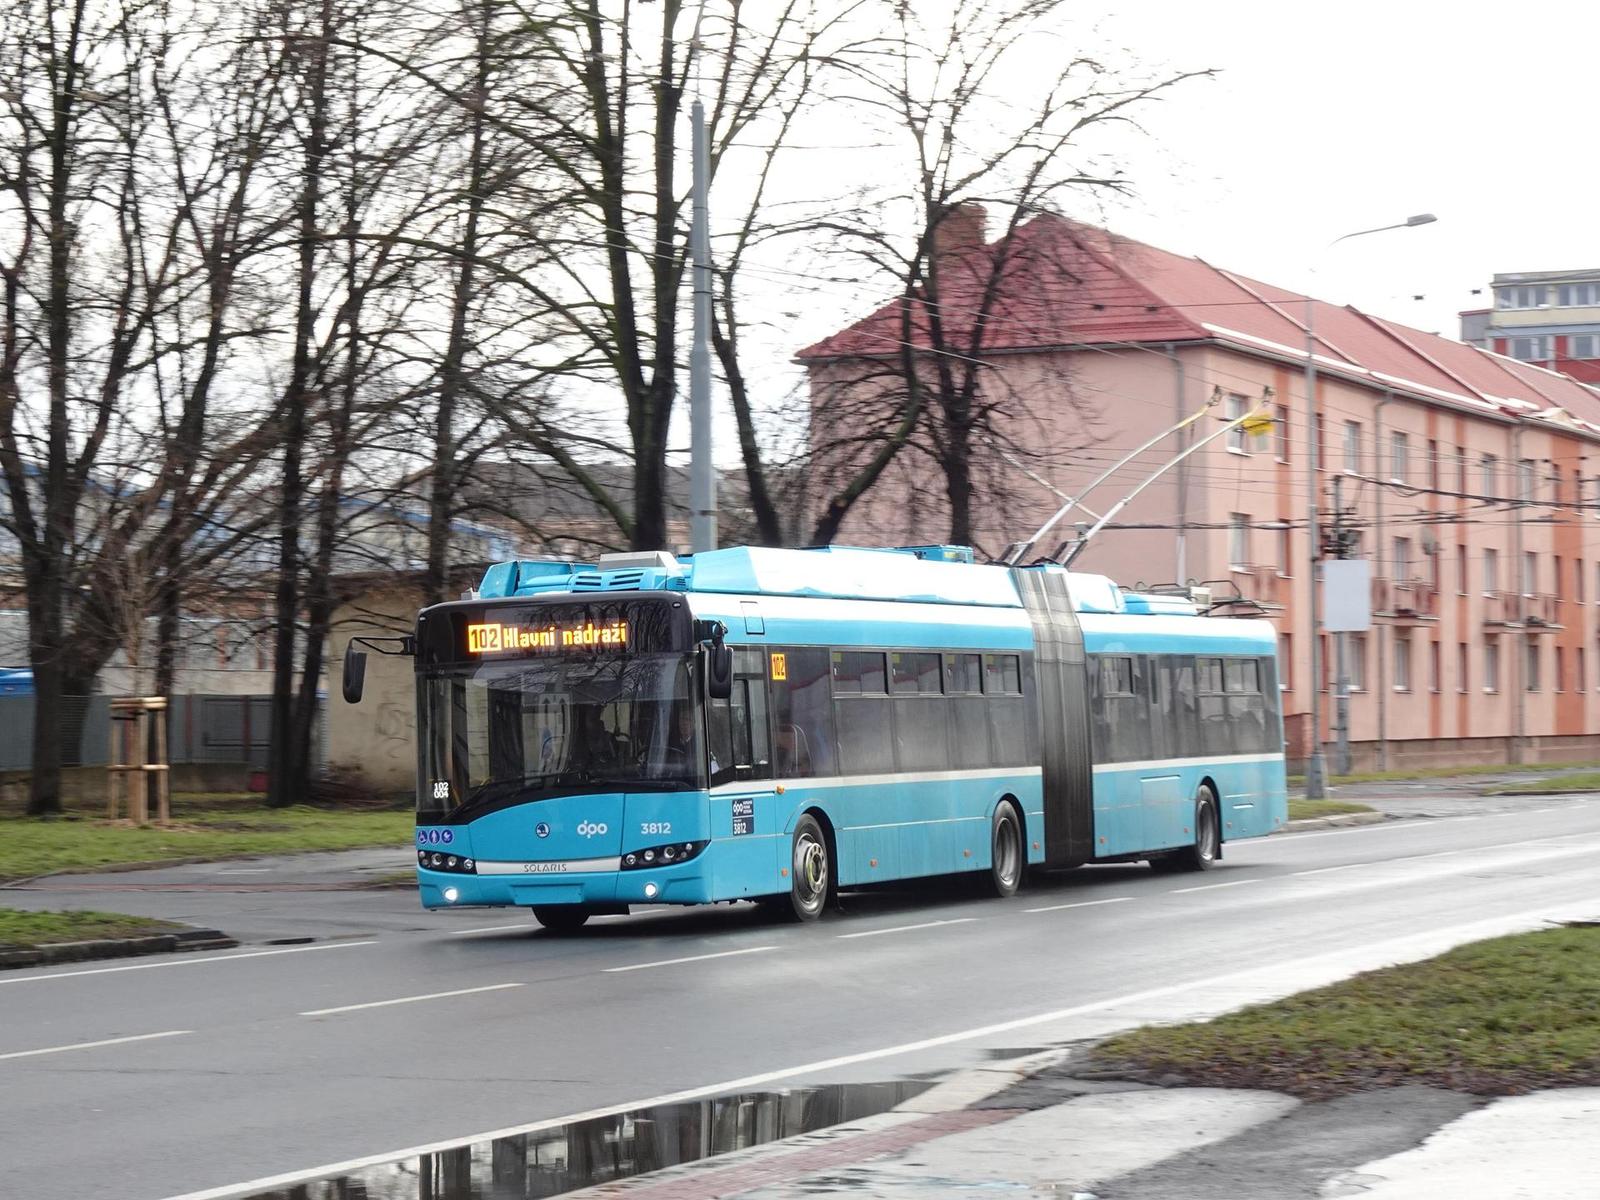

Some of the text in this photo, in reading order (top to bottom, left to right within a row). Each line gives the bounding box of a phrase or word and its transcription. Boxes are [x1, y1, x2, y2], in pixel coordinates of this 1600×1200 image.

[471, 623, 627, 649] 102 Hlavní nádraží
[773, 655, 784, 677] 102
[434, 781, 449, 790] 102
[434, 790, 449, 798] 004
[576, 820, 608, 839] dpo
[640, 822, 671, 835] 3812
[733, 822, 747, 834] 3812
[524, 863, 567, 873] SOLARIS
